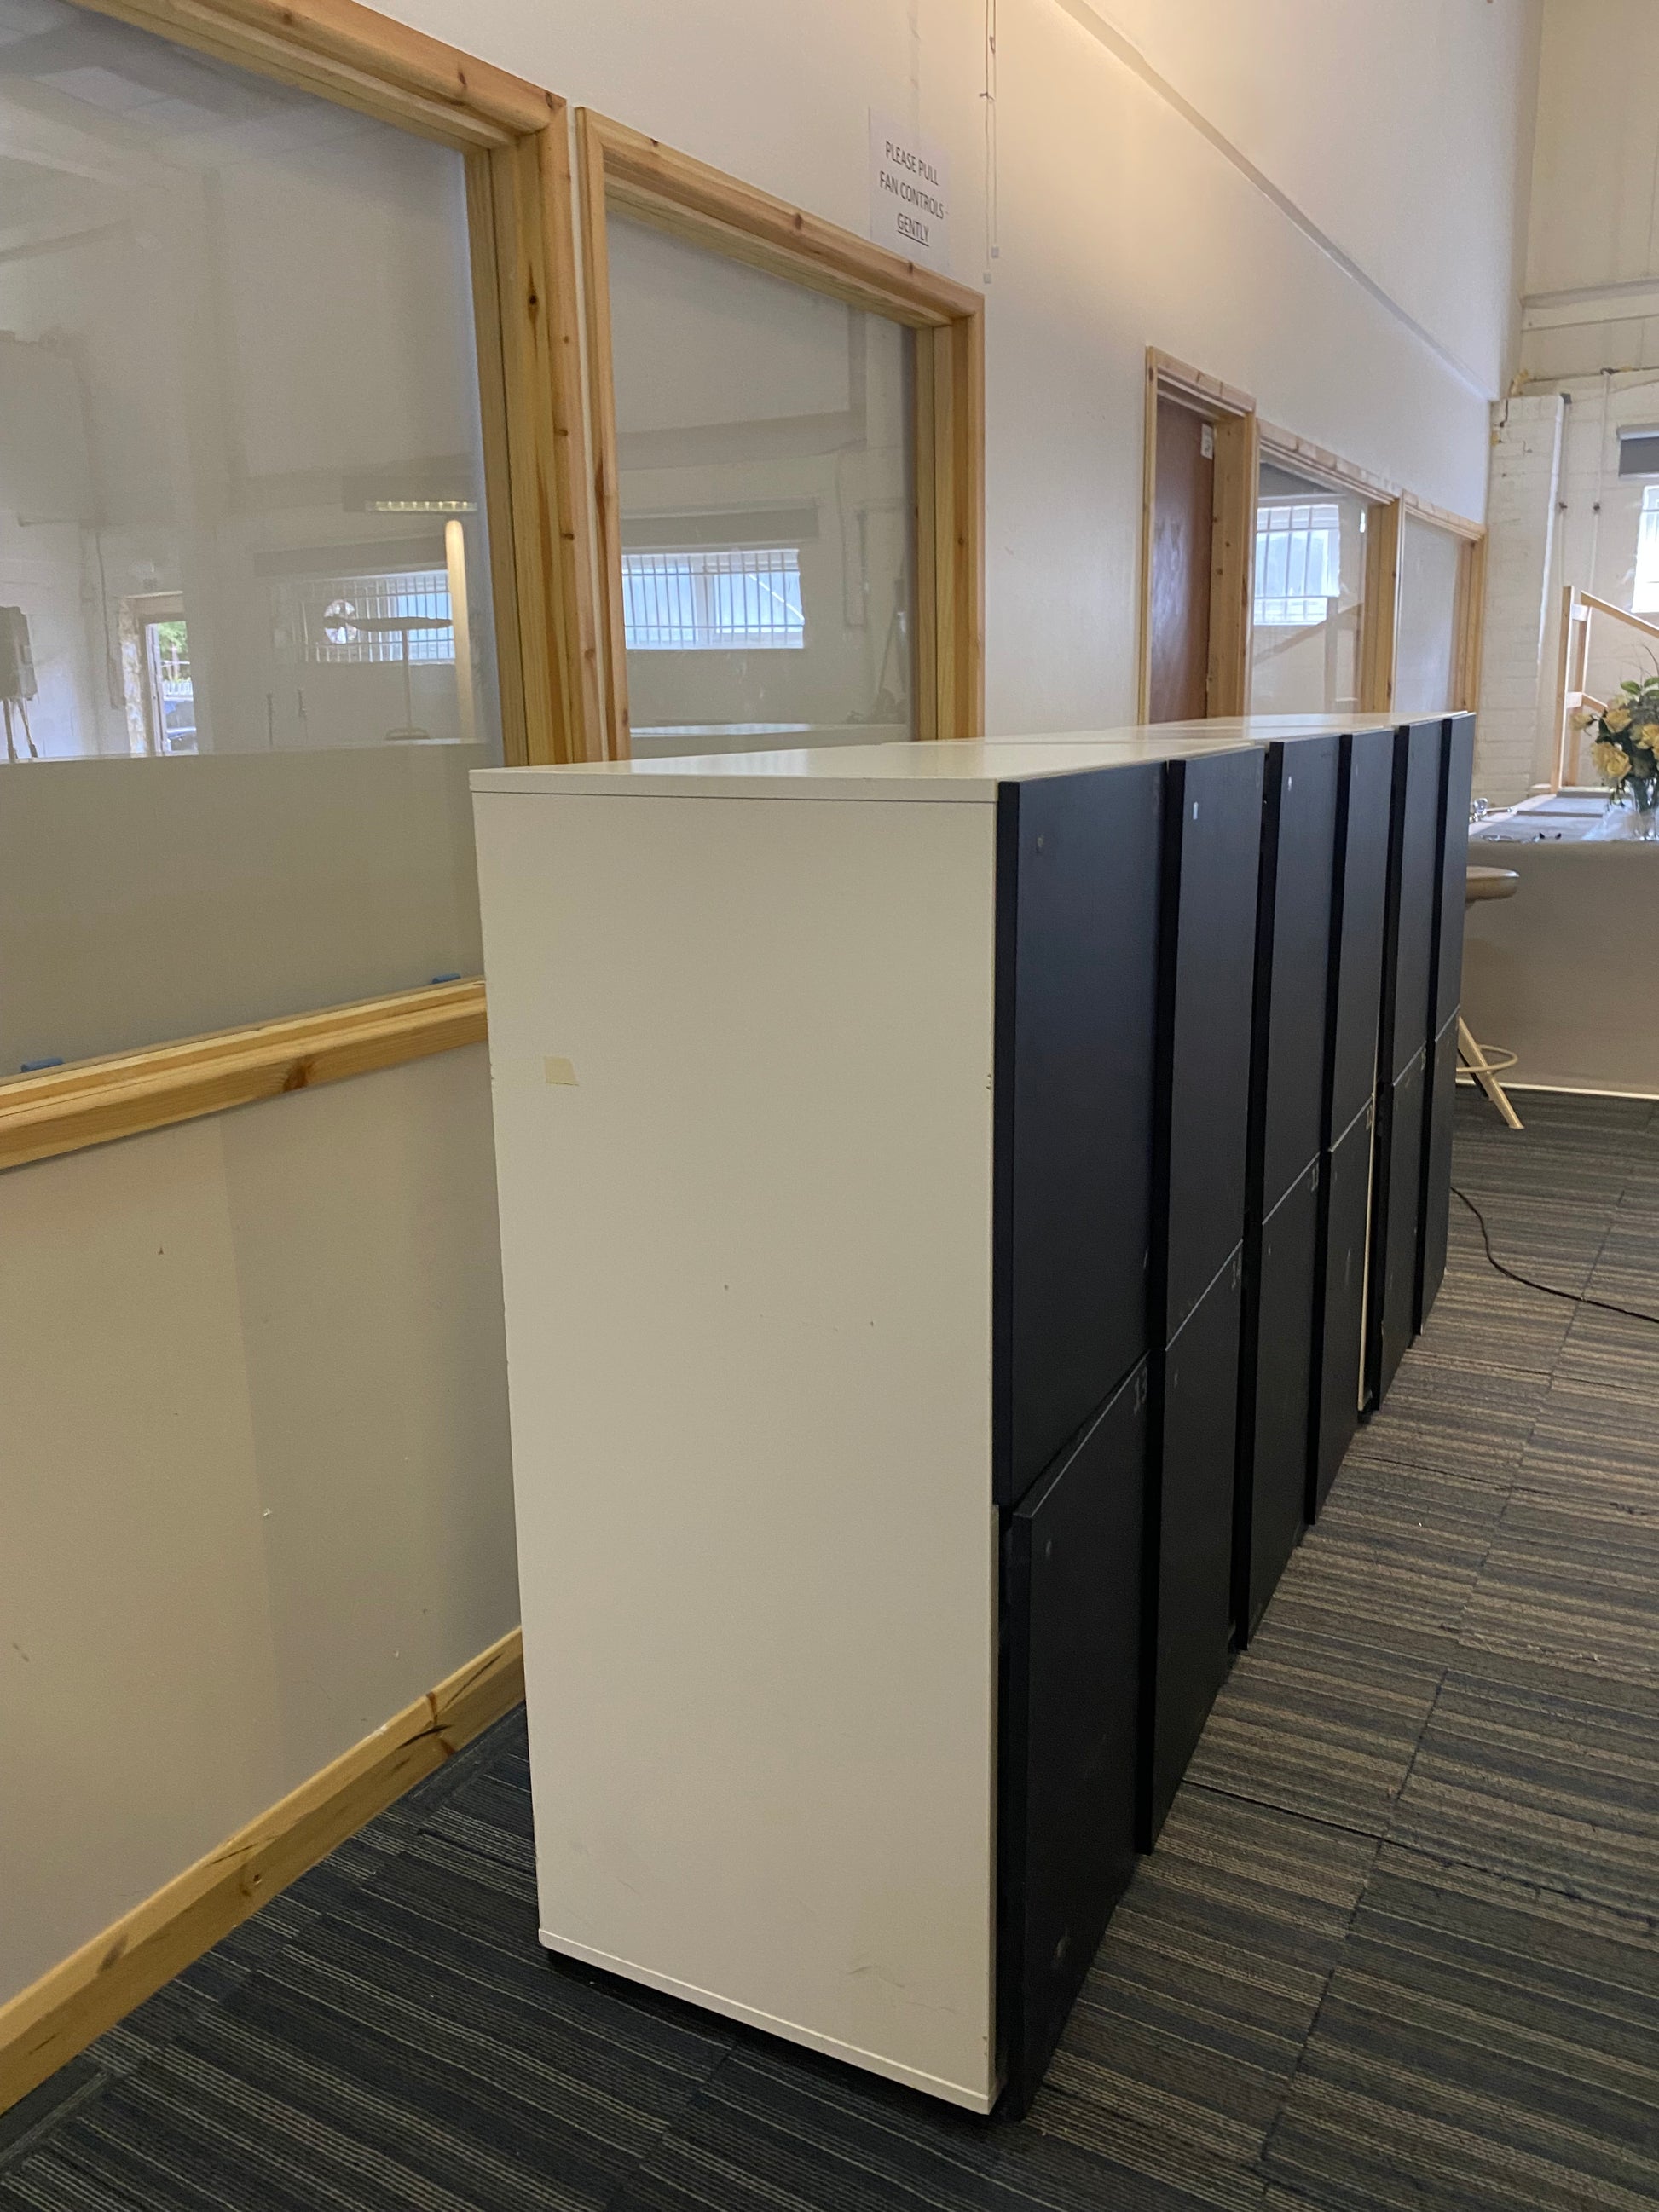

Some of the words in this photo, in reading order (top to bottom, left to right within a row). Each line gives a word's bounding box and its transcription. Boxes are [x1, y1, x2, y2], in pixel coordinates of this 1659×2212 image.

[885, 140, 916, 174] PLEASE
[918, 159, 939, 186] PULL
[879, 170, 899, 195] FAN
[899, 182, 944, 220] CONTROLS
[897, 212, 930, 245] GENTLY
